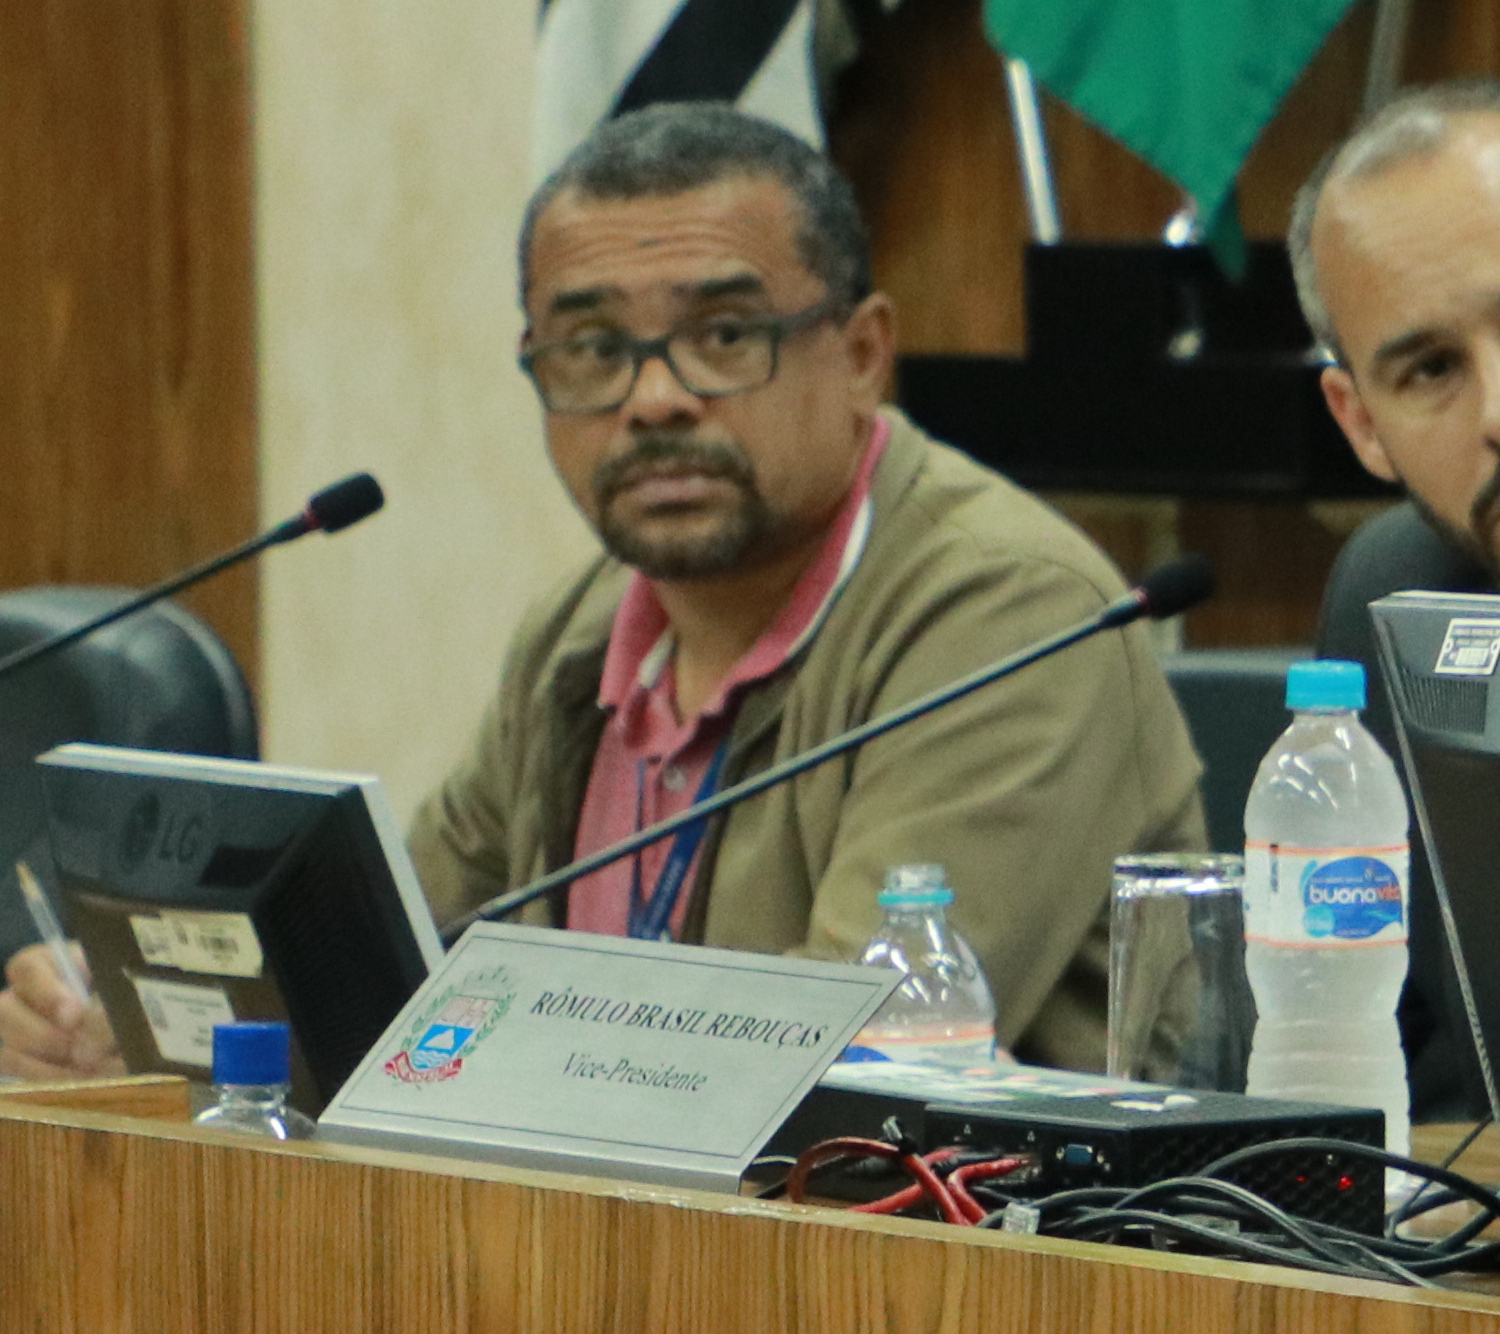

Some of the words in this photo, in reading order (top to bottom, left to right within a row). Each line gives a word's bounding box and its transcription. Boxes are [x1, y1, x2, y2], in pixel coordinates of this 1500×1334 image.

[625, 1003, 706, 1035] BRASIL
[703, 1016, 829, 1049] REBOUÇAS
[562, 1051, 708, 1092] Vice-Presidente
